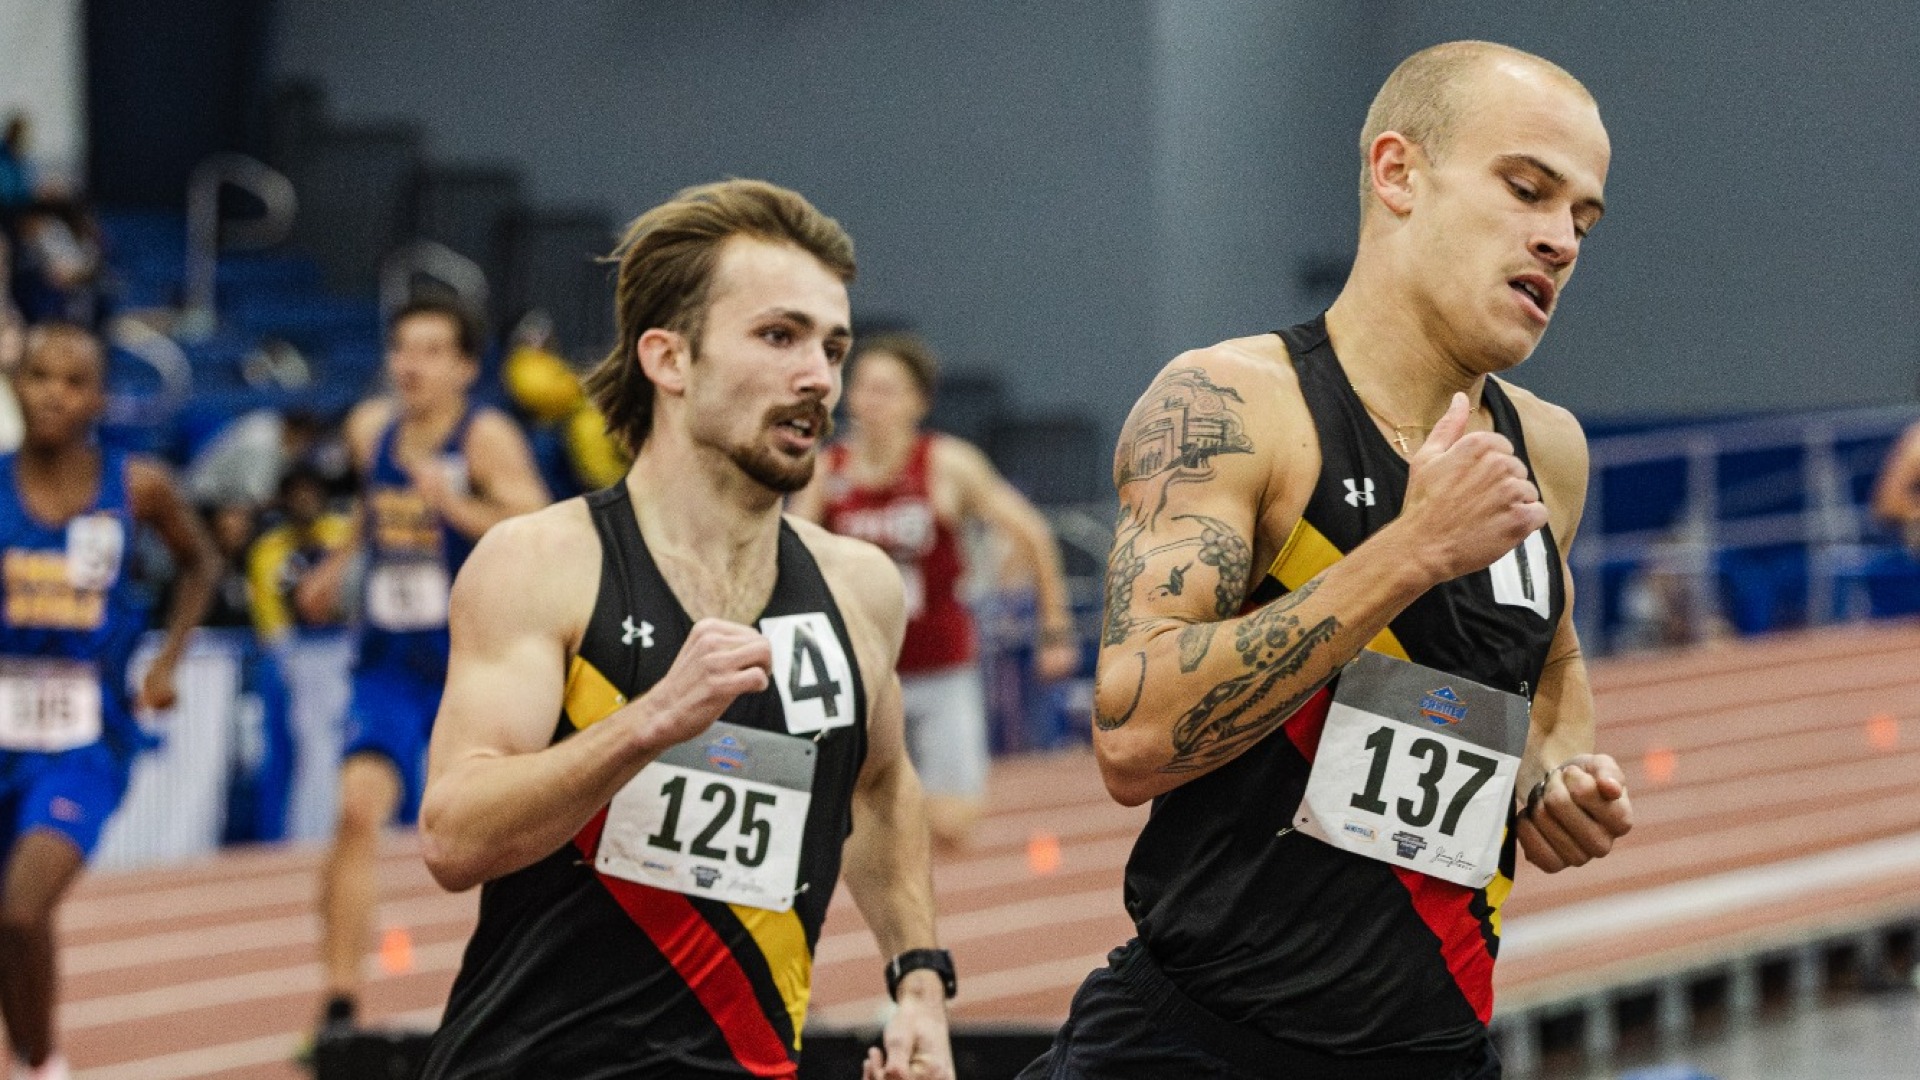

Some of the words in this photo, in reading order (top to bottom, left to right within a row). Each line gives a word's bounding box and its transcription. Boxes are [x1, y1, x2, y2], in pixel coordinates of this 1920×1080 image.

[788, 621, 842, 718] 4
[647, 775, 778, 868] 125
[1349, 726, 1499, 837] 137
